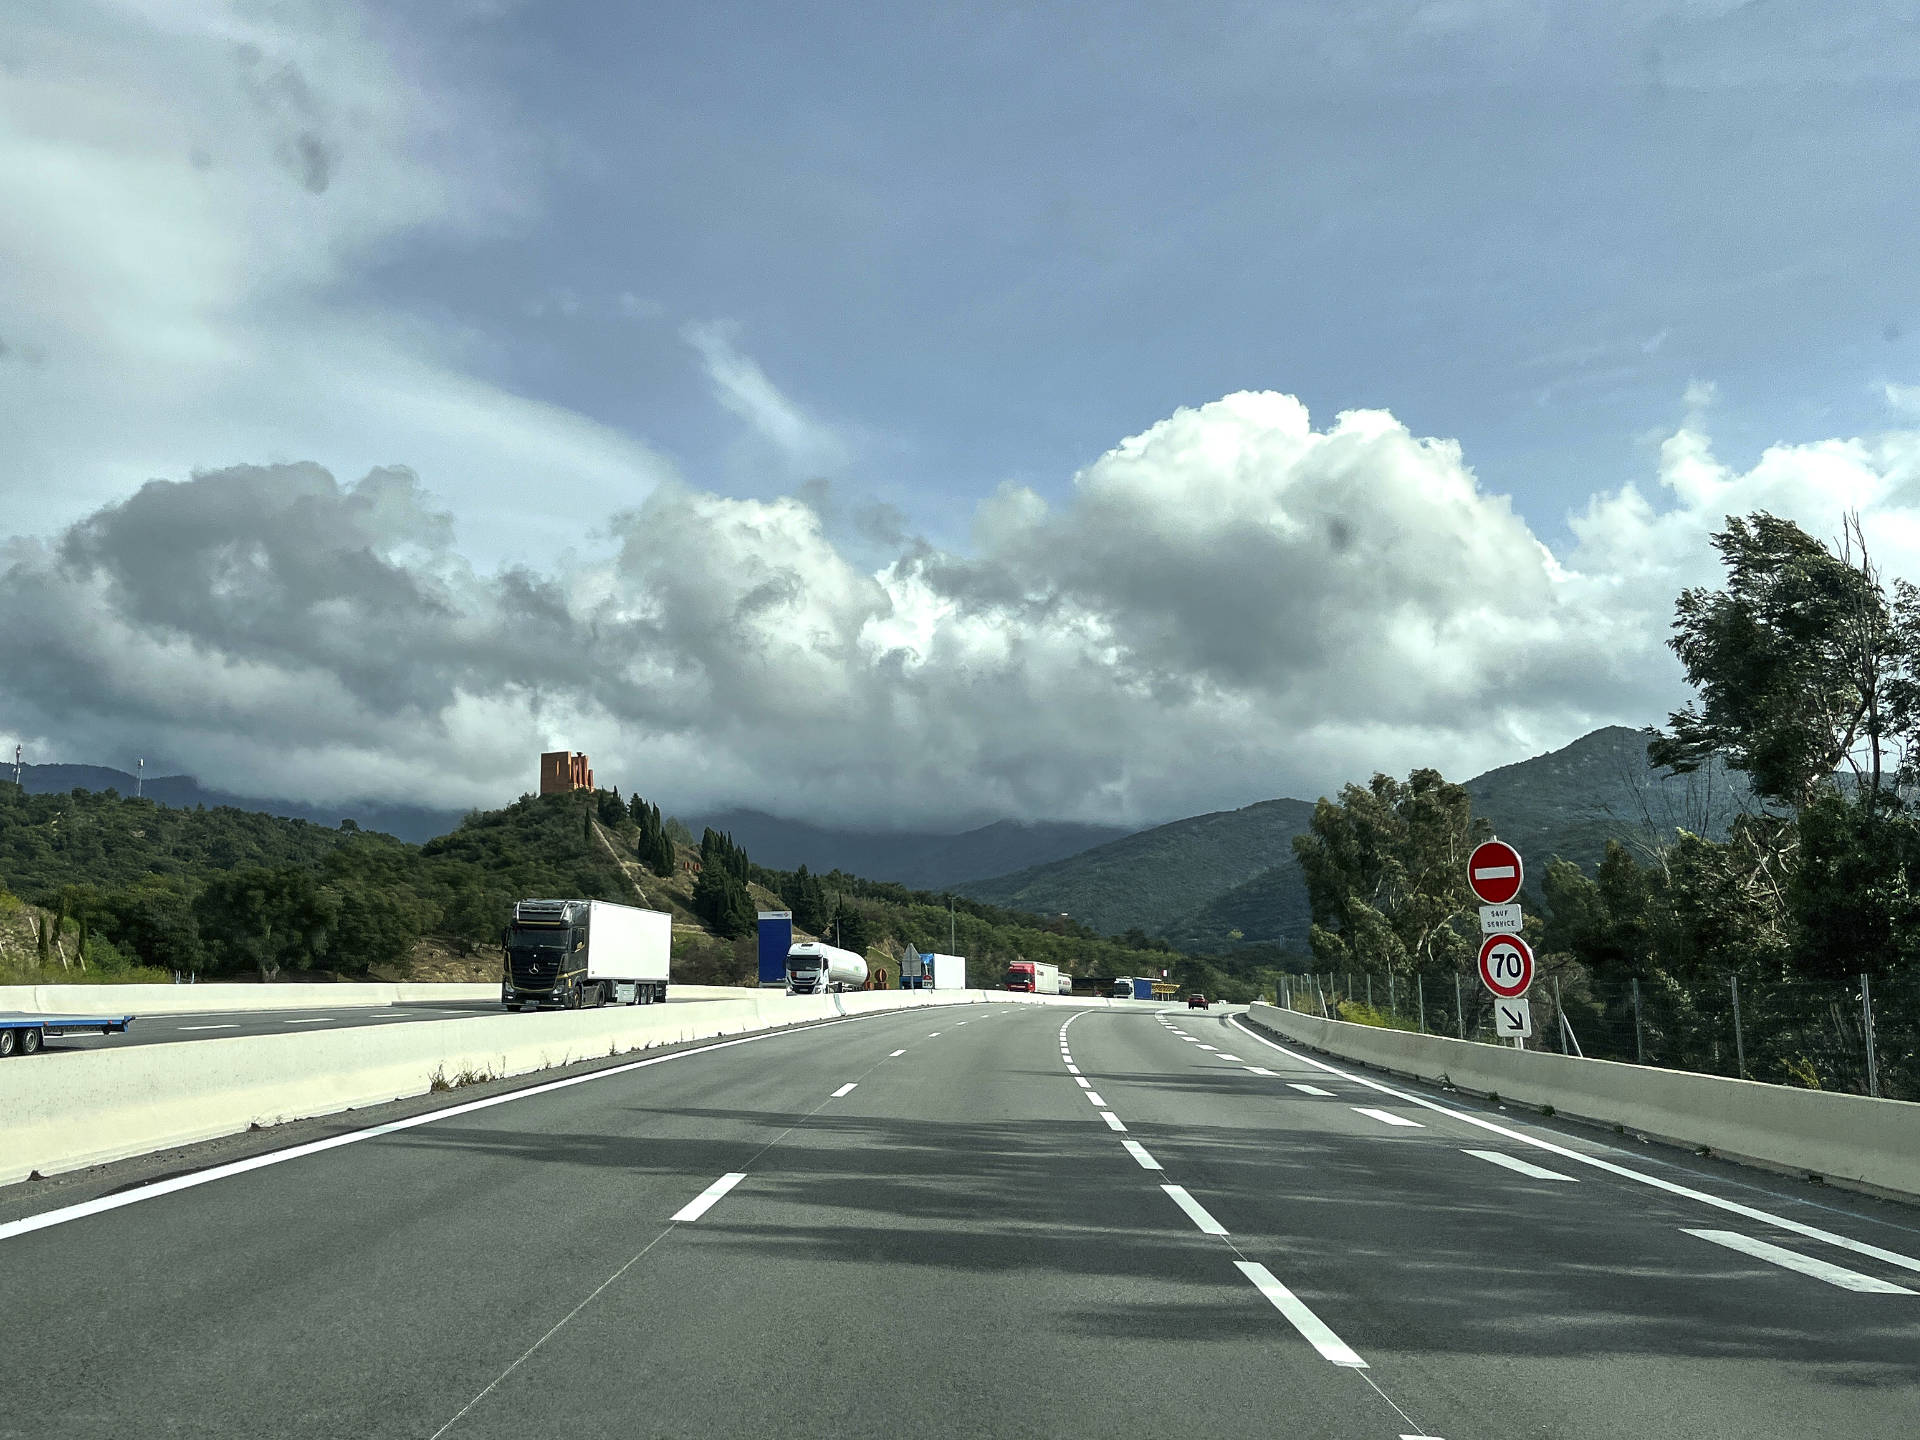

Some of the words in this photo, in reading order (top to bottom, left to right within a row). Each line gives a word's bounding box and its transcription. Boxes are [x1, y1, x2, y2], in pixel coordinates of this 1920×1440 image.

[1490, 910, 1509, 918] SAUF
[1487, 920, 1516, 928] SERVICE
[1491, 953, 1521, 978] 70
